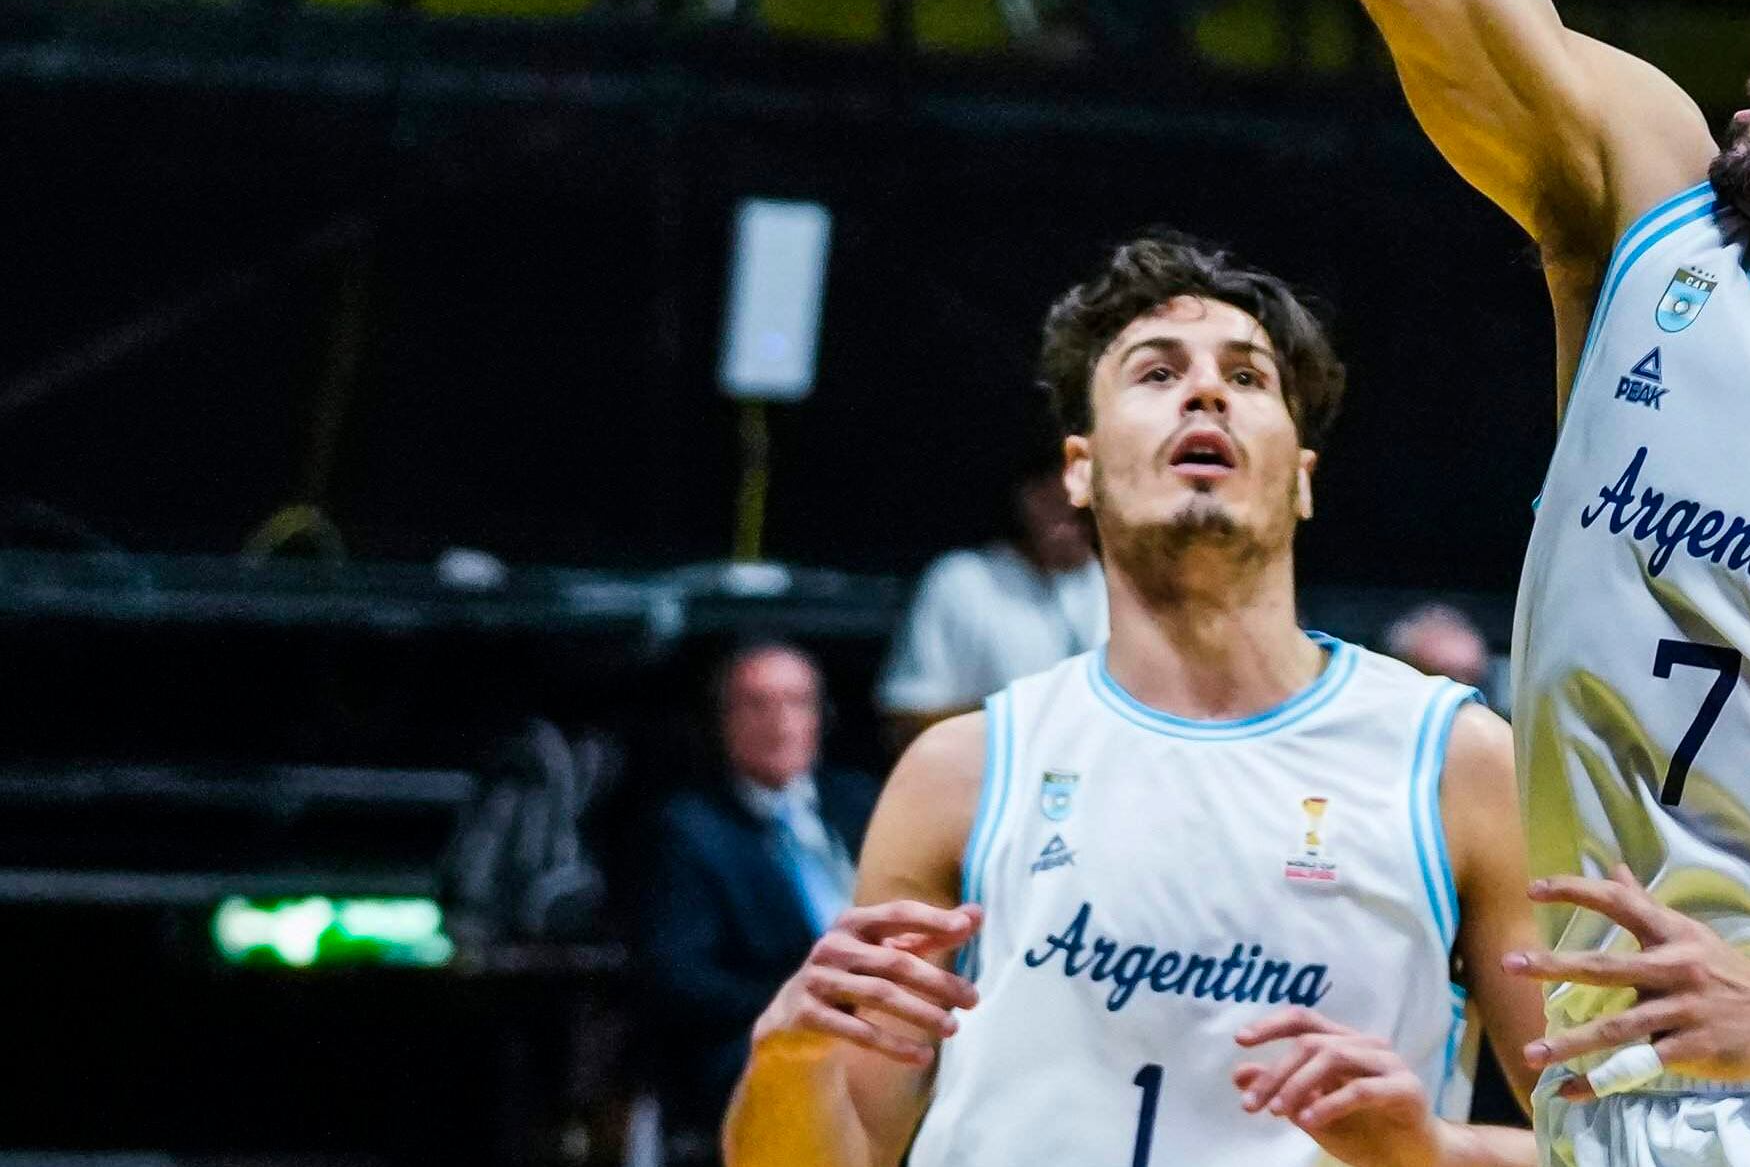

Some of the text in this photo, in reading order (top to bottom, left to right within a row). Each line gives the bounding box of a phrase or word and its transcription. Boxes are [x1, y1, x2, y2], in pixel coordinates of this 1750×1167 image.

[1614, 375, 1671, 410] PEAK
[1652, 637, 1743, 806] 7
[1025, 901, 1333, 1012] Argentina
[1132, 1063, 1164, 1167] 1
